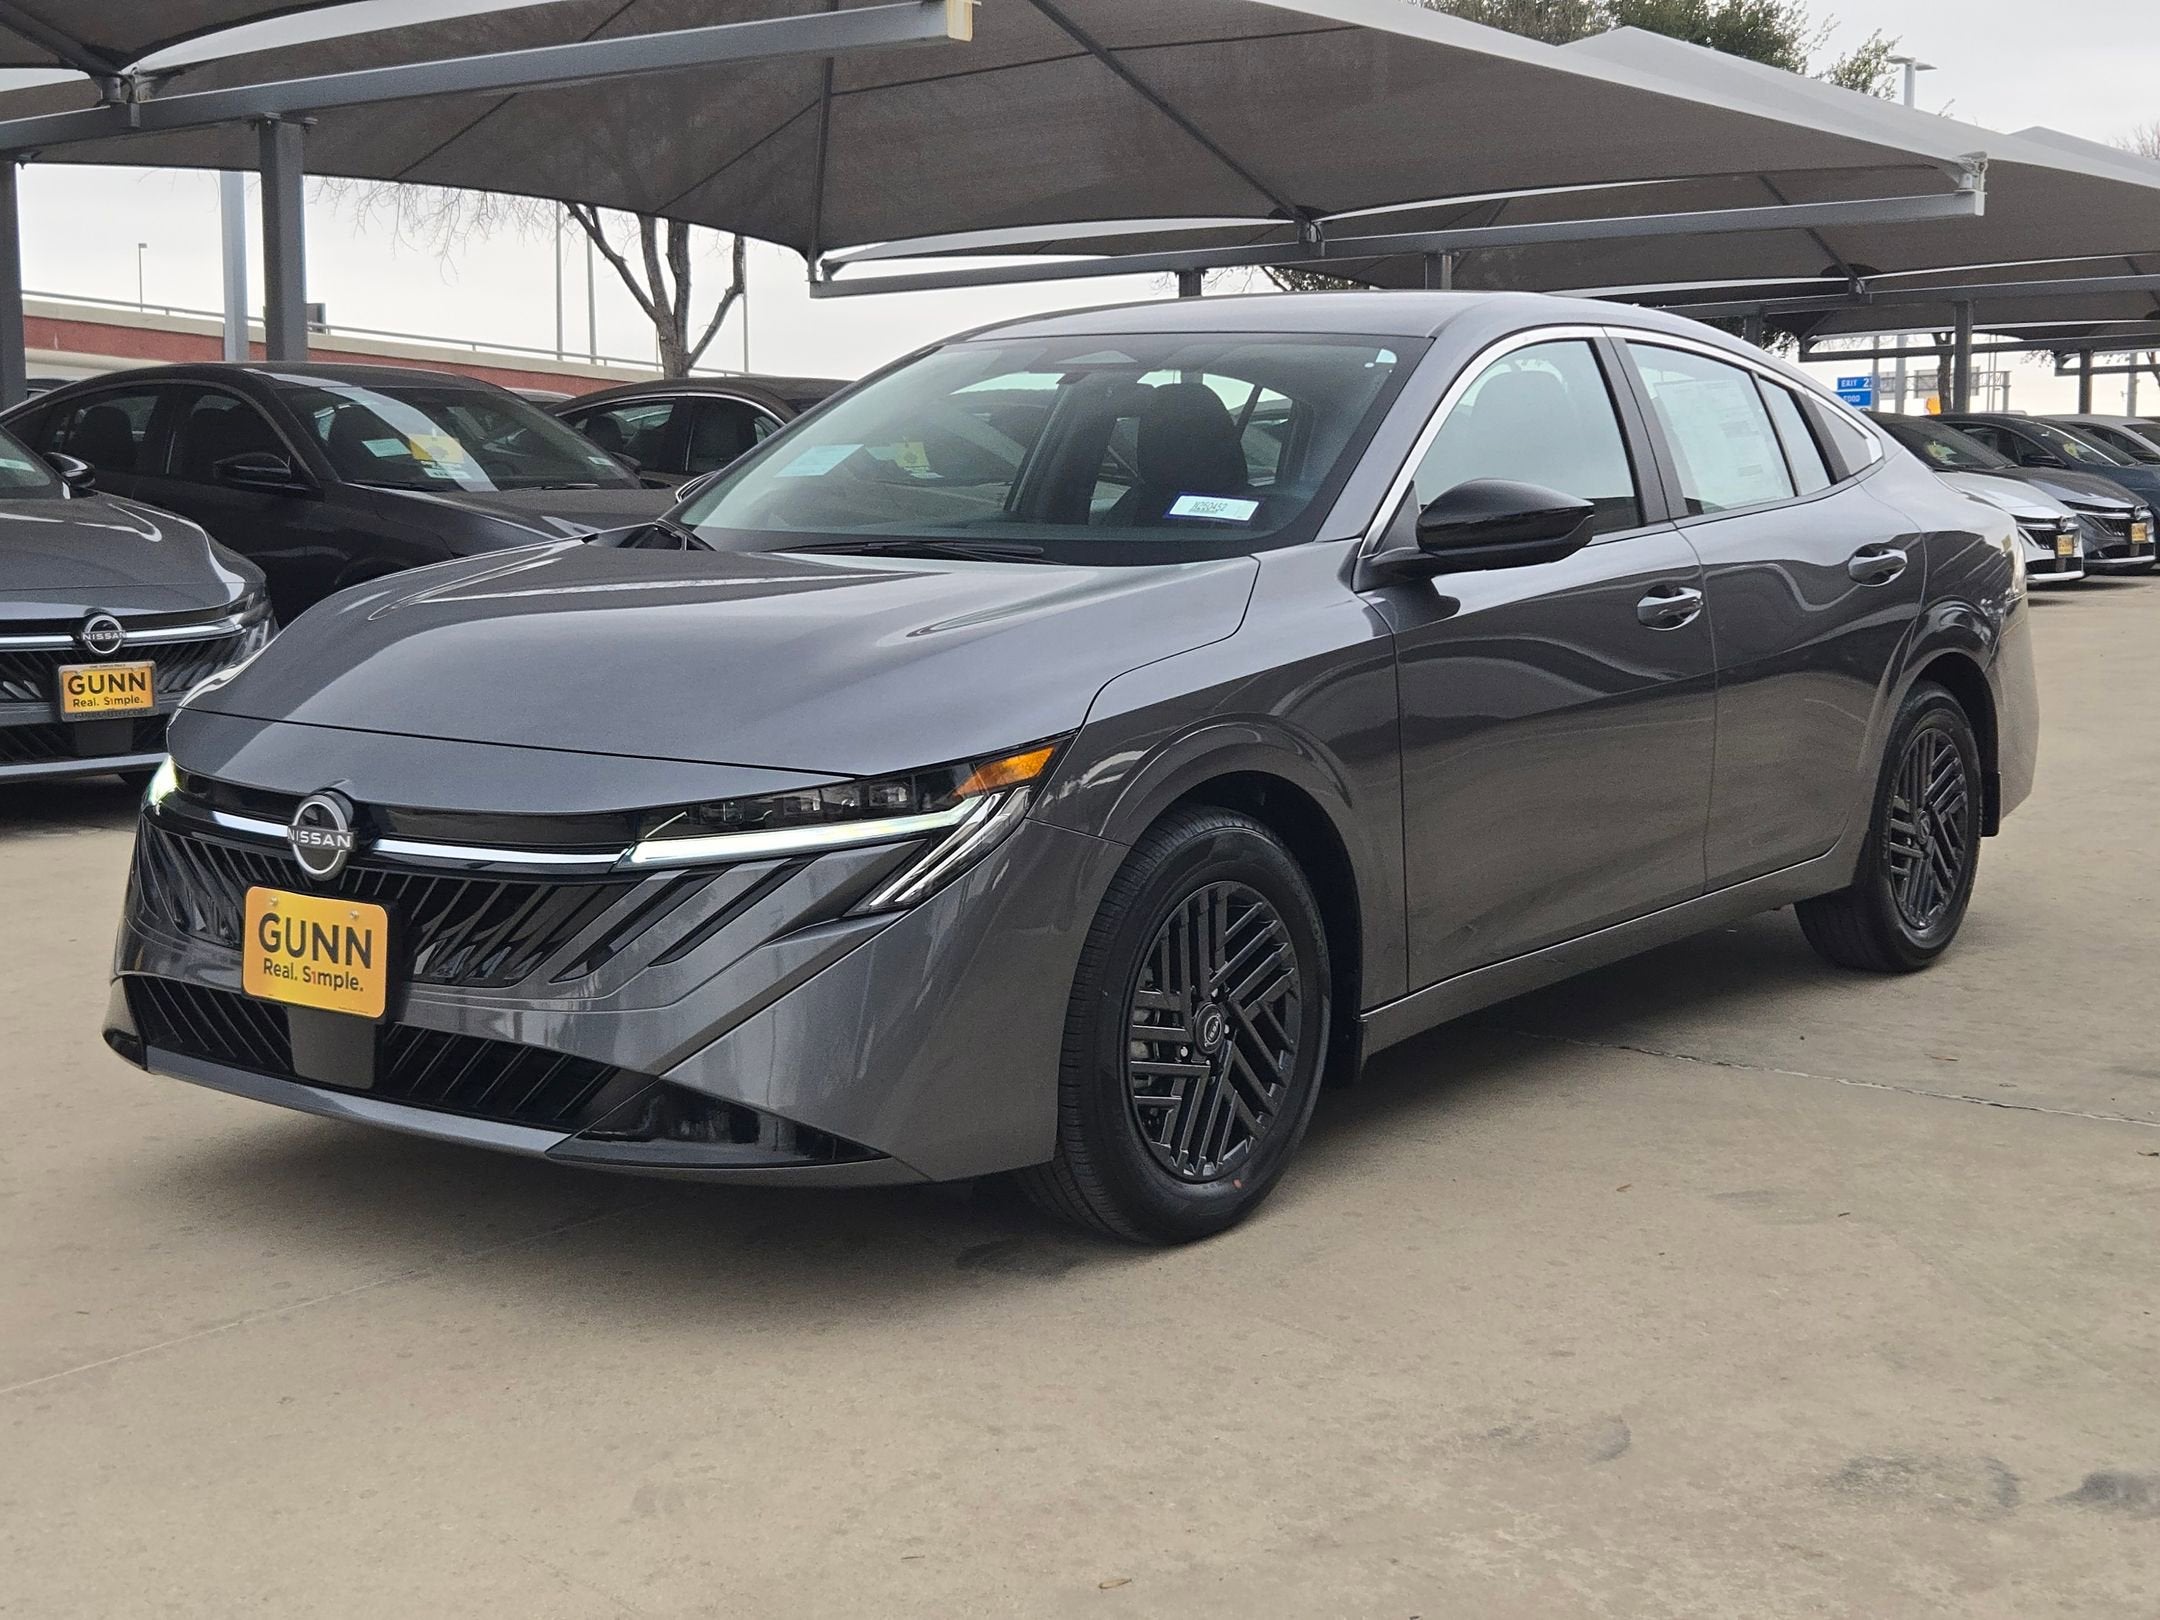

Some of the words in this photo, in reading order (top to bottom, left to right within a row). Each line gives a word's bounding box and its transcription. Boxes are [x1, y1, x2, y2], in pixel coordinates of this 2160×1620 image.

[1841, 379, 1857, 387] EXIT
[82, 631, 127, 640] NISSAN
[67, 672, 146, 695] GUNN
[73, 698, 100, 707] Real.
[287, 827, 353, 848] NISSAN
[258, 912, 372, 969] GUNN
[263, 958, 298, 980] Real.
